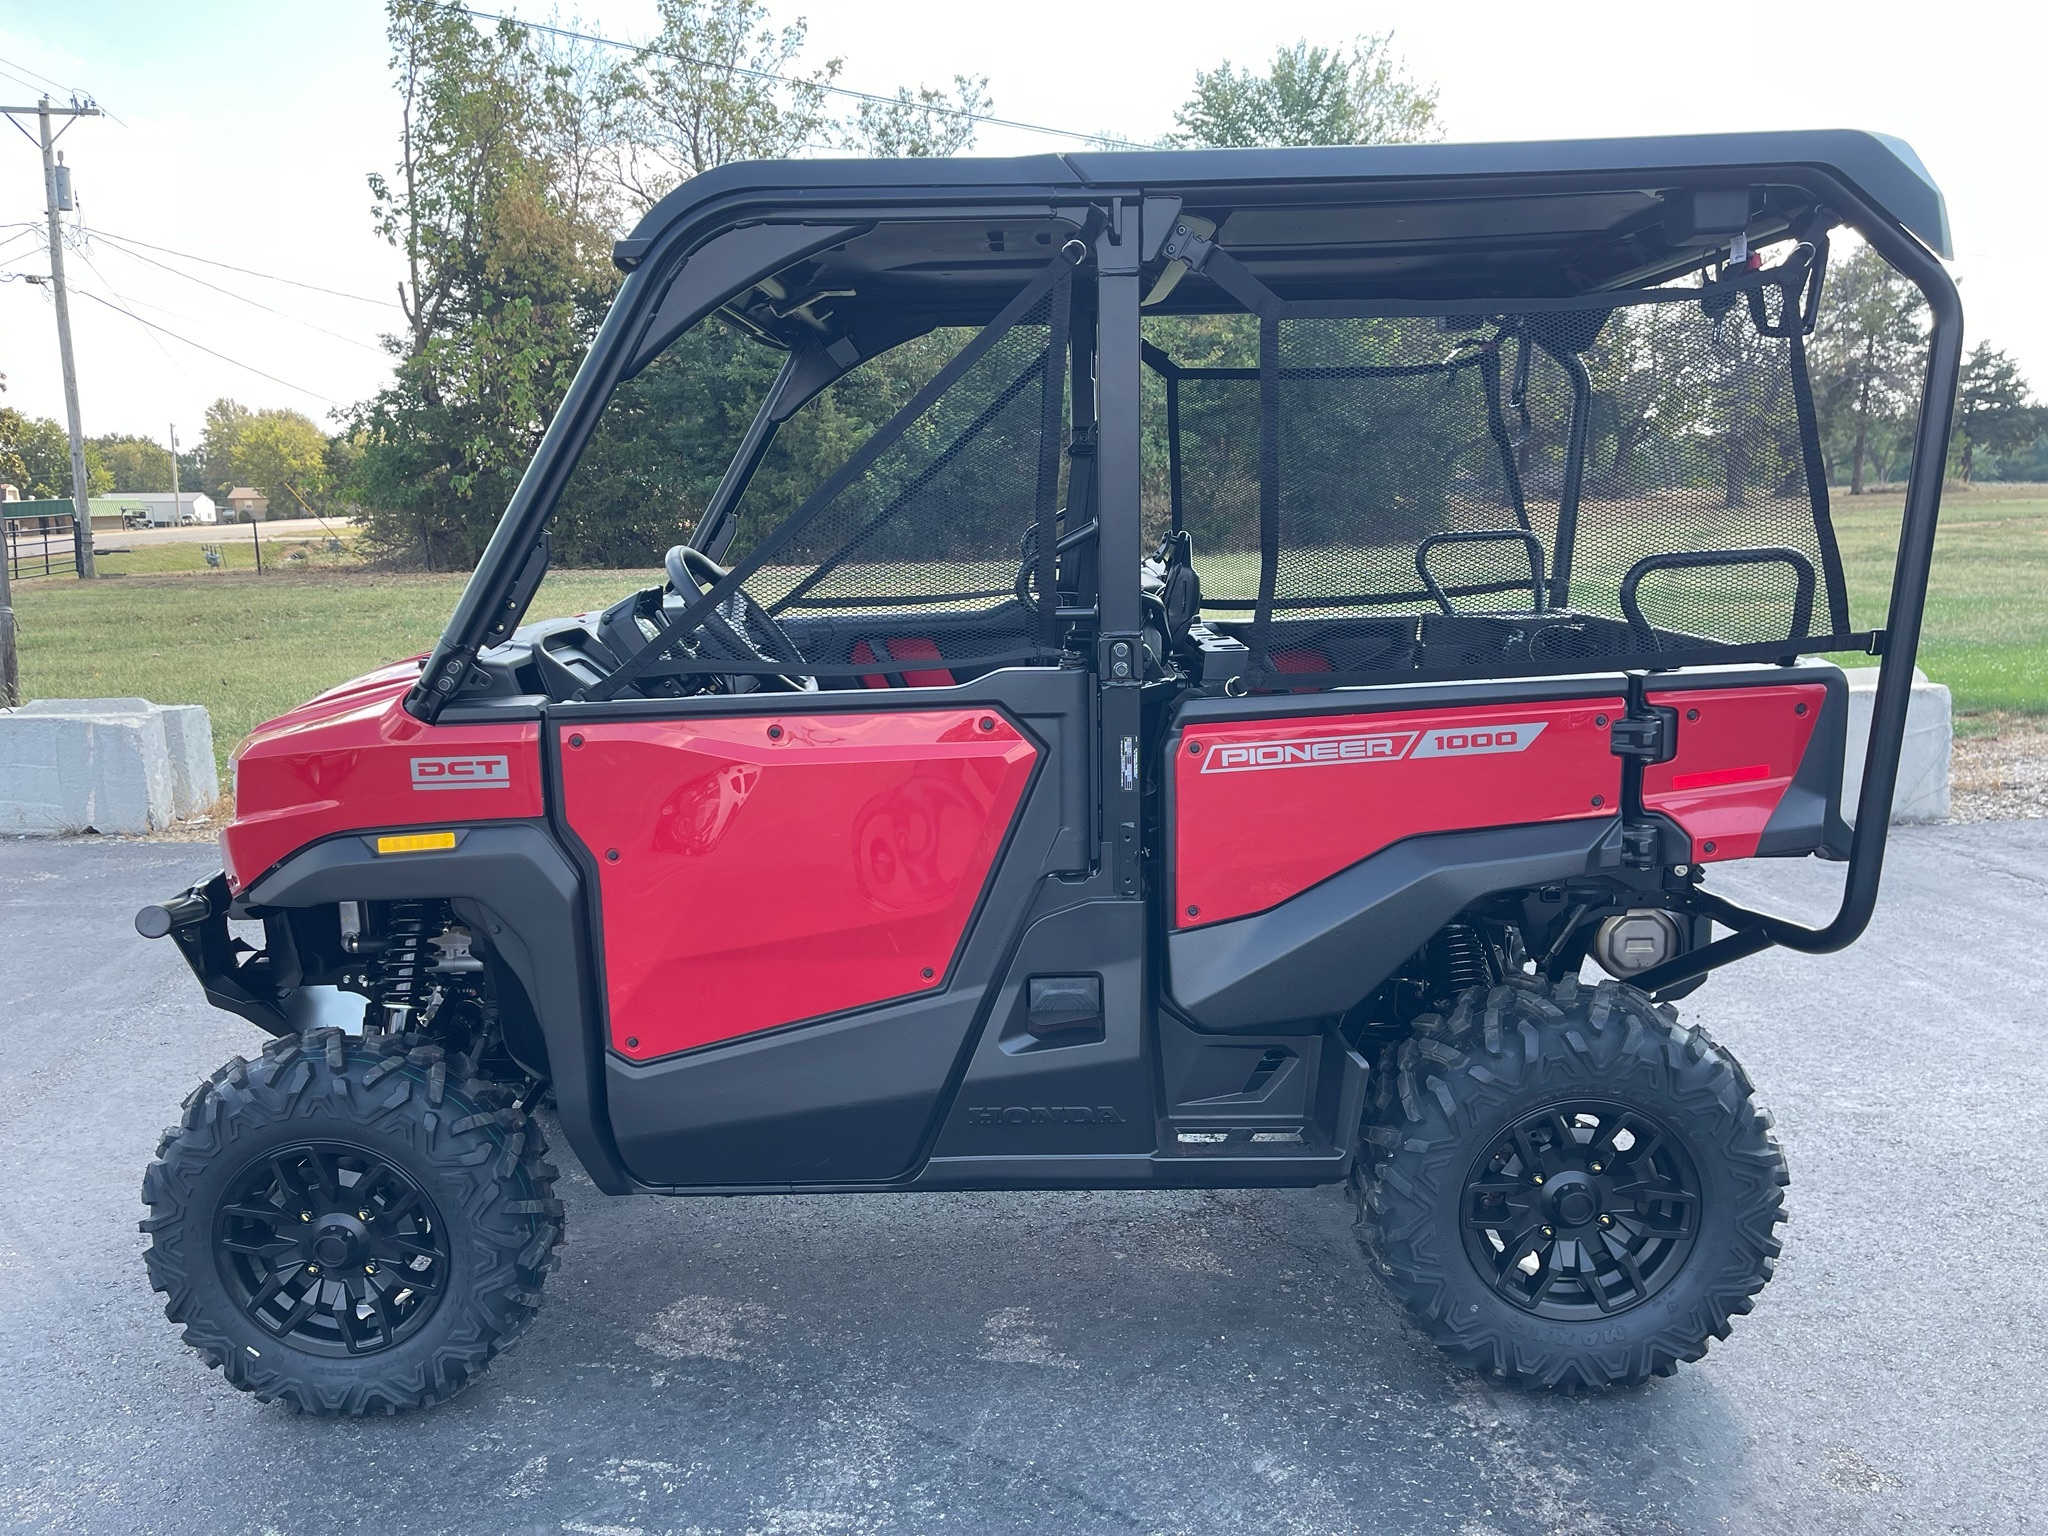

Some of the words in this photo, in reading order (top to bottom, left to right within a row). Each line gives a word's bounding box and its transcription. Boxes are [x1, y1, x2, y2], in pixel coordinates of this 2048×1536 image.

[1221, 738, 1393, 767] PIONEER
[1434, 731, 1518, 750] 1000
[417, 760, 502, 776] DCT
[968, 1106, 1127, 1124] HONDA
